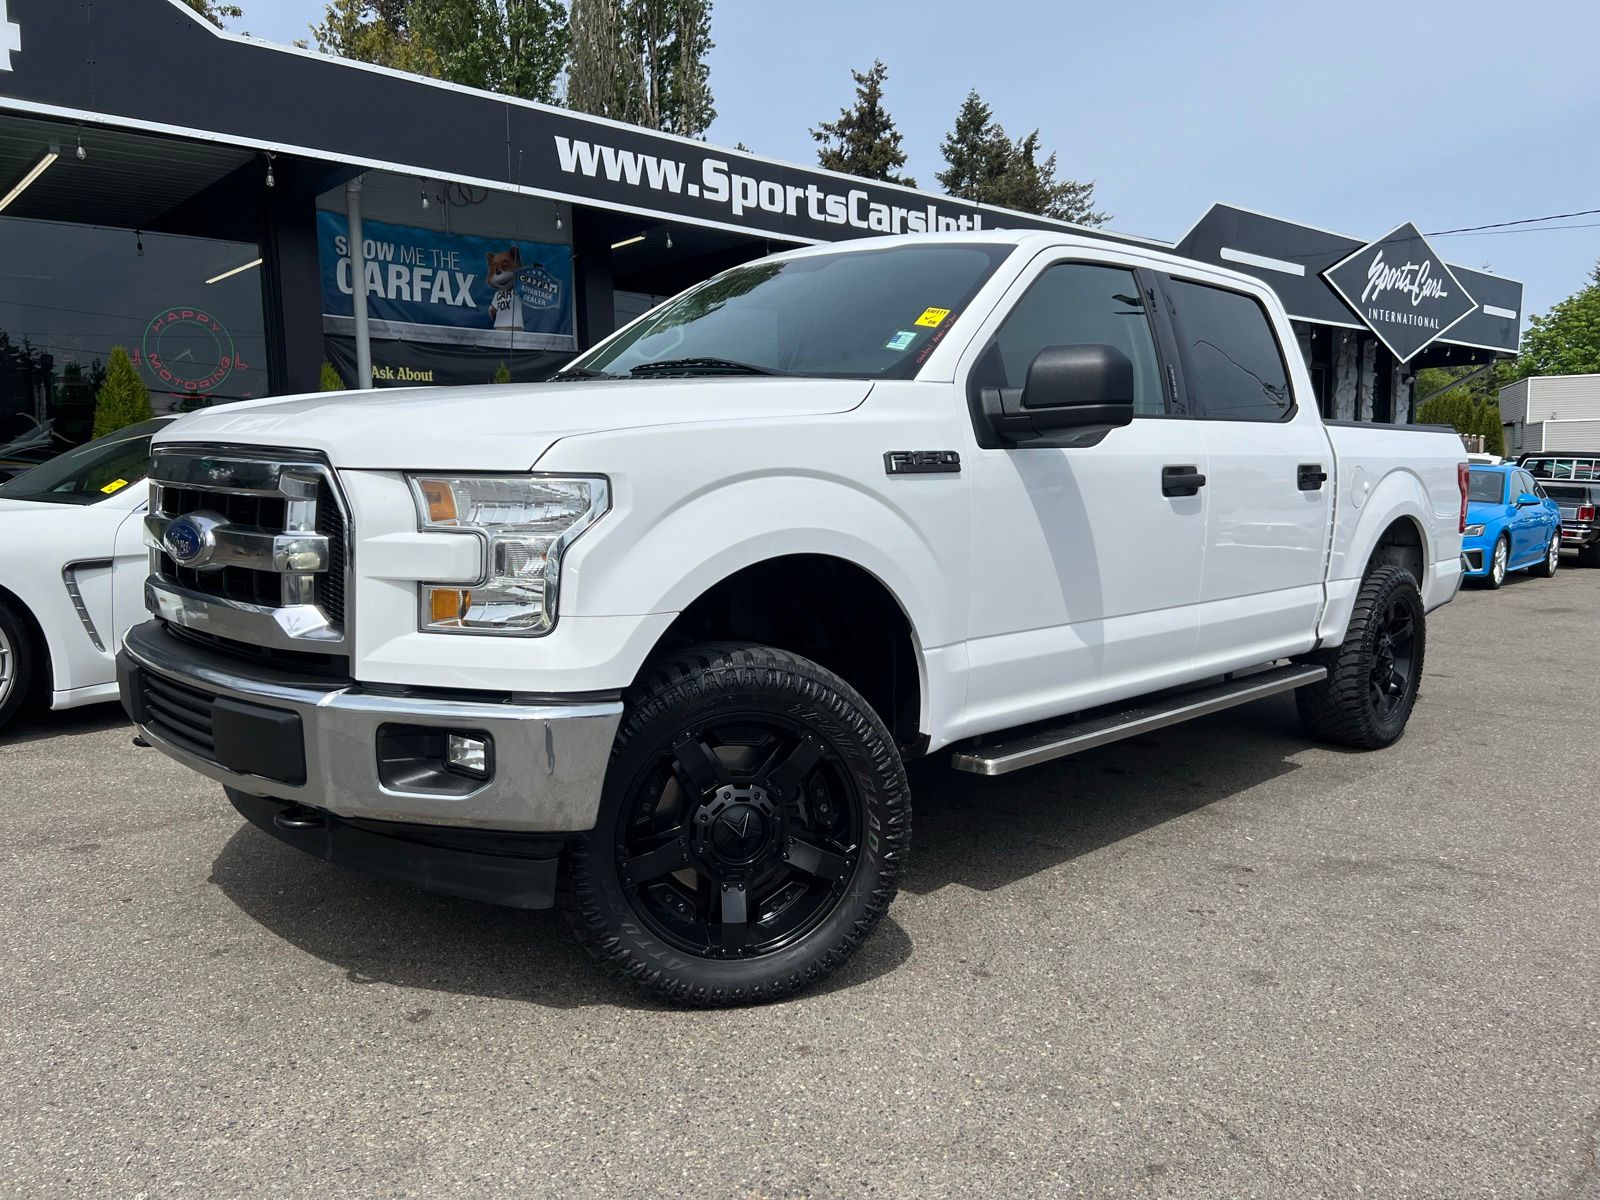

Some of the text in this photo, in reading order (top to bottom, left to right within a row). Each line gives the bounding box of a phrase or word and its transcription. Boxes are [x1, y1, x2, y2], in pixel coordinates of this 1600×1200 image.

[335, 235, 460, 270] SOW ME THE
[336, 257, 477, 307] CARFAX
[520, 274, 558, 293] CARFAX
[1361, 249, 1448, 306] Sports Cars
[521, 285, 553, 300] ADVANTAGE
[523, 294, 546, 306] DEALER
[497, 300, 511, 311] FOX
[152, 310, 221, 331] HAPPY
[1368, 307, 1439, 329] INTERNATIONAL
[149, 353, 230, 390] MOTORING
[372, 365, 433, 382] Ask About
